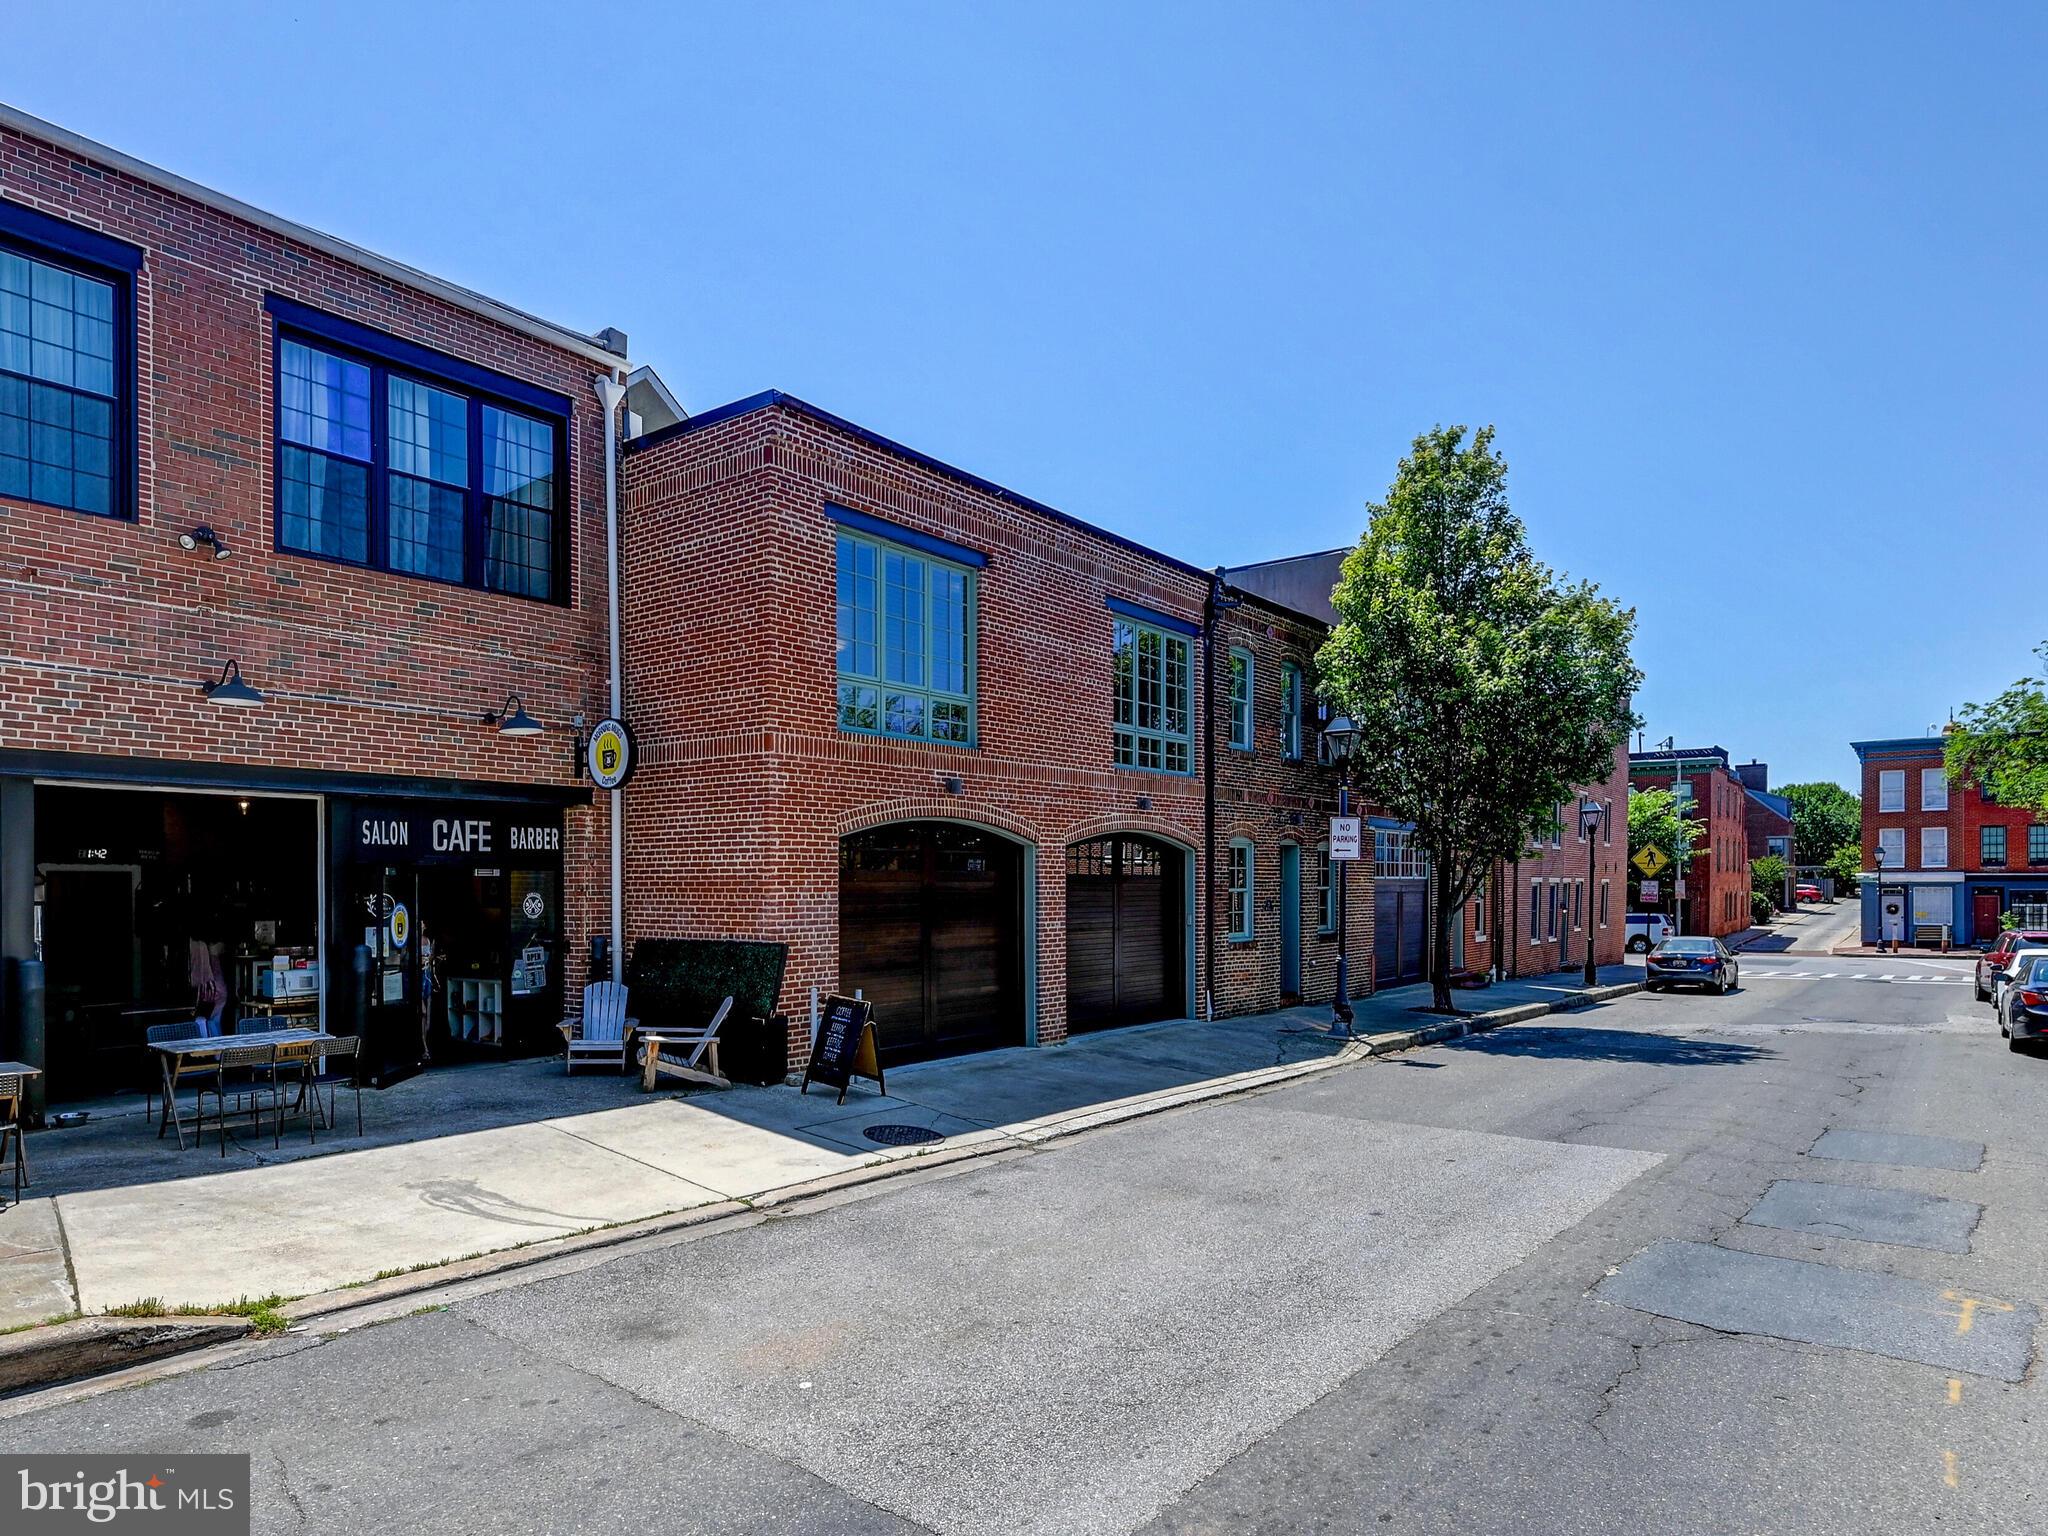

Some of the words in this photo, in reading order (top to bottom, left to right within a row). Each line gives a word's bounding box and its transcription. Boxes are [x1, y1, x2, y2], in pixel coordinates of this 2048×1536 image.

[602, 776, 617, 785] Coffee
[362, 820, 408, 845] SALON
[432, 818, 492, 852] CAFE
[510, 826, 559, 850] BARBER
[1333, 835, 1357, 843] PARKING
[88, 849, 107, 858] 1:42
[527, 953, 541, 961] OPEN
